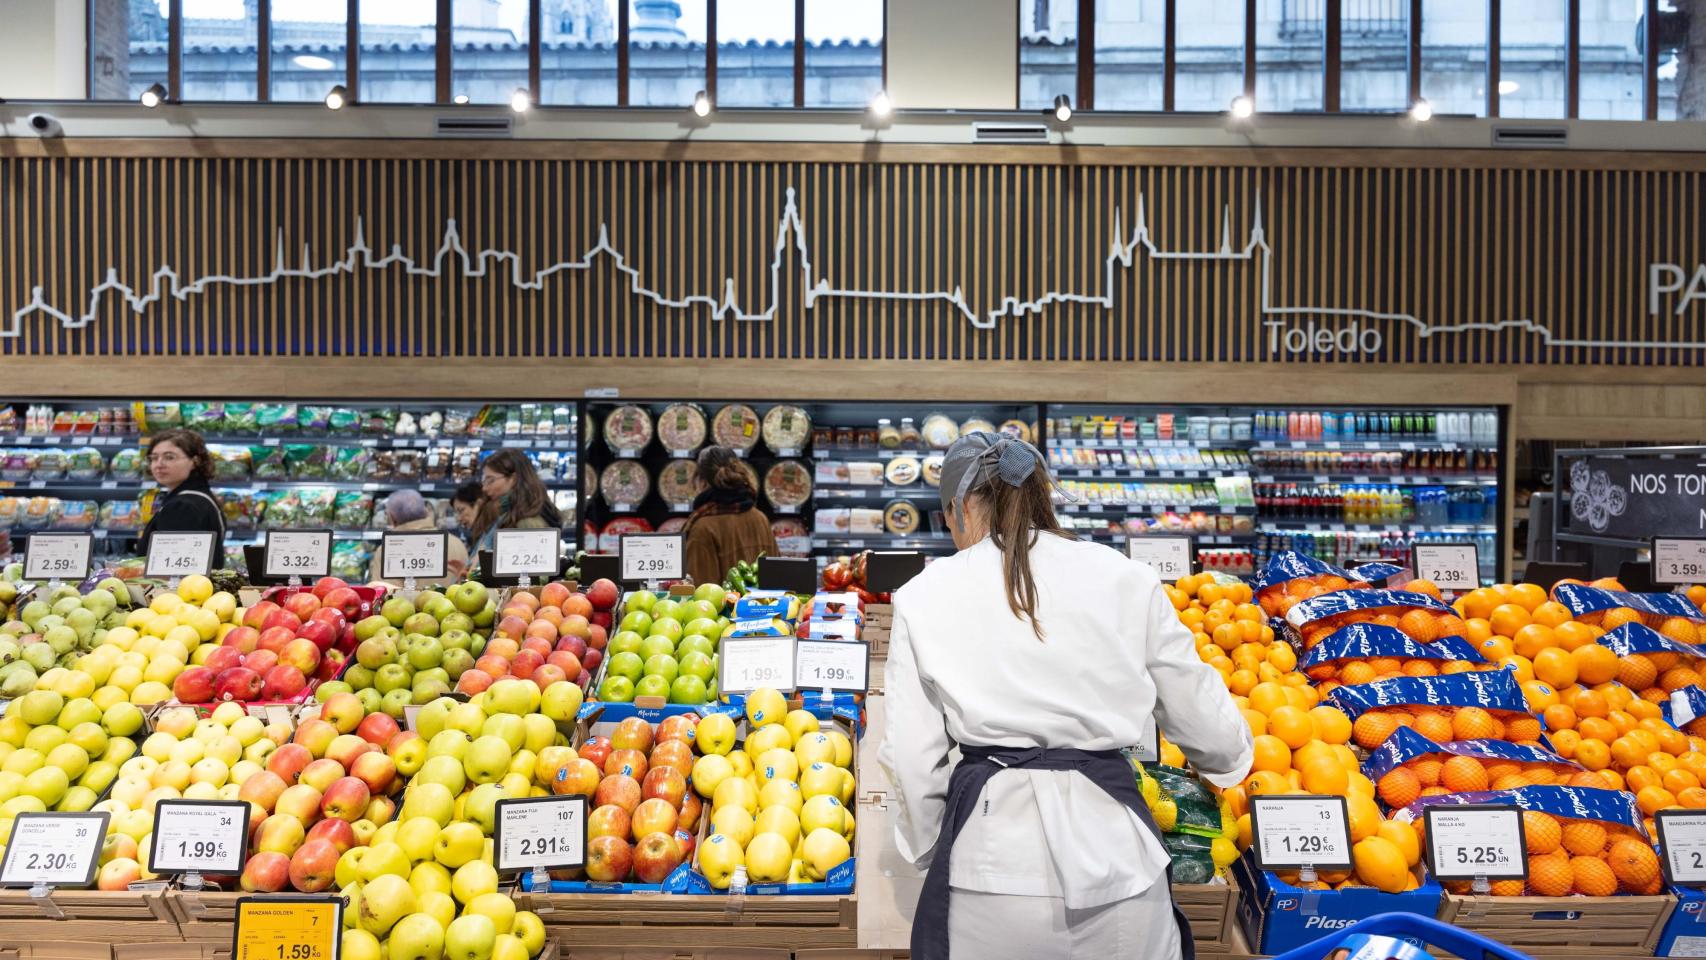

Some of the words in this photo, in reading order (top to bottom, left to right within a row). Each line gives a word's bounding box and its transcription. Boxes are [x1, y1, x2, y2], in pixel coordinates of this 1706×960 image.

[1263, 320, 1382, 353] Toledo
[1630, 474, 1667, 496] NOS
[41, 559, 70, 571] 2.59
[164, 557, 192, 568] 1.45
[282, 555, 310, 567] 3.32
[399, 558, 426, 569] 1.99
[511, 554, 538, 566] 2.24
[637, 559, 665, 571] 2.99
[1671, 563, 1698, 575] 3.59
[1433, 570, 1460, 581] 2.39
[1559, 584, 1585, 614] Ripoll
[1352, 625, 1372, 656] Ripoll
[742, 667, 773, 681] 1.99
[814, 667, 845, 680] 1.99
[1467, 672, 1492, 707] Ripoll
[1560, 785, 1590, 818] Ripoll
[220, 817, 232, 826] 34
[557, 811, 574, 820] 107
[1319, 811, 1331, 820] 13
[75, 828, 88, 837] 30
[520, 837, 556, 855] 2.91
[1282, 835, 1322, 852] 1.29
[1322, 836, 1329, 844] €
[179, 841, 216, 858] 1.99
[1322, 844, 1335, 852] KG
[1498, 847, 1505, 855] €
[1457, 846, 1497, 863] 5.25
[1498, 855, 1509, 863] UN
[26, 853, 67, 870] 2.30
[311, 916, 319, 926] 7
[1305, 916, 1359, 929] Plase
[277, 944, 311, 960] 1.59
